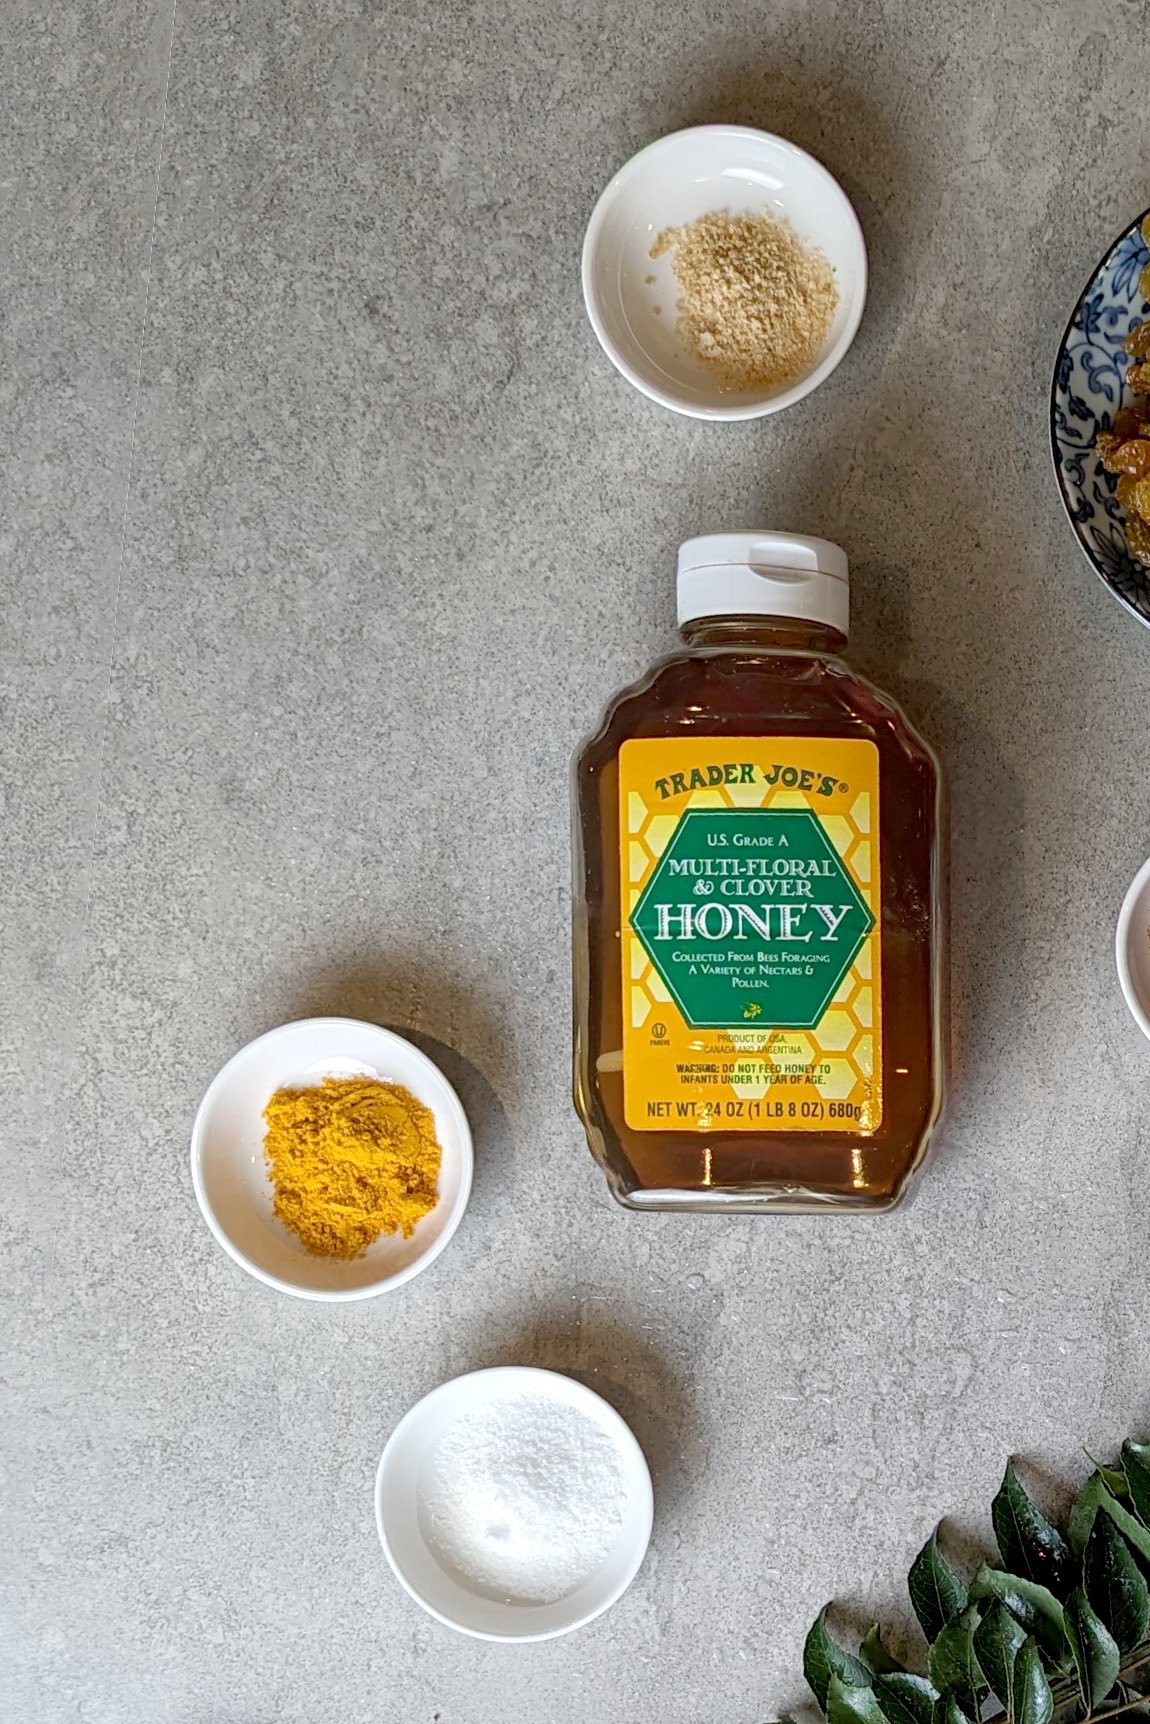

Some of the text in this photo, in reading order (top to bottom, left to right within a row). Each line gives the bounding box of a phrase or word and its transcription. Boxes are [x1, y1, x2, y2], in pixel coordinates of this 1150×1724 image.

[654, 763, 756, 800] TRADER
[707, 834, 729, 846] U.S.
[778, 834, 788, 846] A
[668, 858, 836, 878] MULTI-FLORAL
[692, 879, 814, 898] & CLOVER
[653, 902, 854, 943] HONEY
[688, 964, 698, 975] A
[804, 965, 814, 976] &
[718, 1034, 756, 1042] PRODUCT
[757, 1034, 766, 1042] OF
[704, 1046, 802, 1054] CANADA AND ARGENTINA
[722, 1064, 735, 1073] DO
[738, 1064, 756, 1073] NOT
[759, 1064, 782, 1073] FEED
[784, 1064, 816, 1074] HONEY
[820, 1064, 831, 1074] TO
[680, 1075, 718, 1084] INFANTS
[721, 1075, 752, 1084] UNDER
[763, 1075, 787, 1084] YEAR
[790, 1075, 803, 1084] OF
[805, 1075, 826, 1084] AGE.
[647, 1102, 672, 1117] NET
[706, 1102, 721, 1117] 24
[726, 1102, 744, 1117] OZ
[748, 1102, 760, 1120] (1
[767, 1102, 784, 1117] LB
[788, 1102, 796, 1117] 8
[801, 1102, 825, 1120] OZ)
[829, 1102, 861, 1121] 680g
